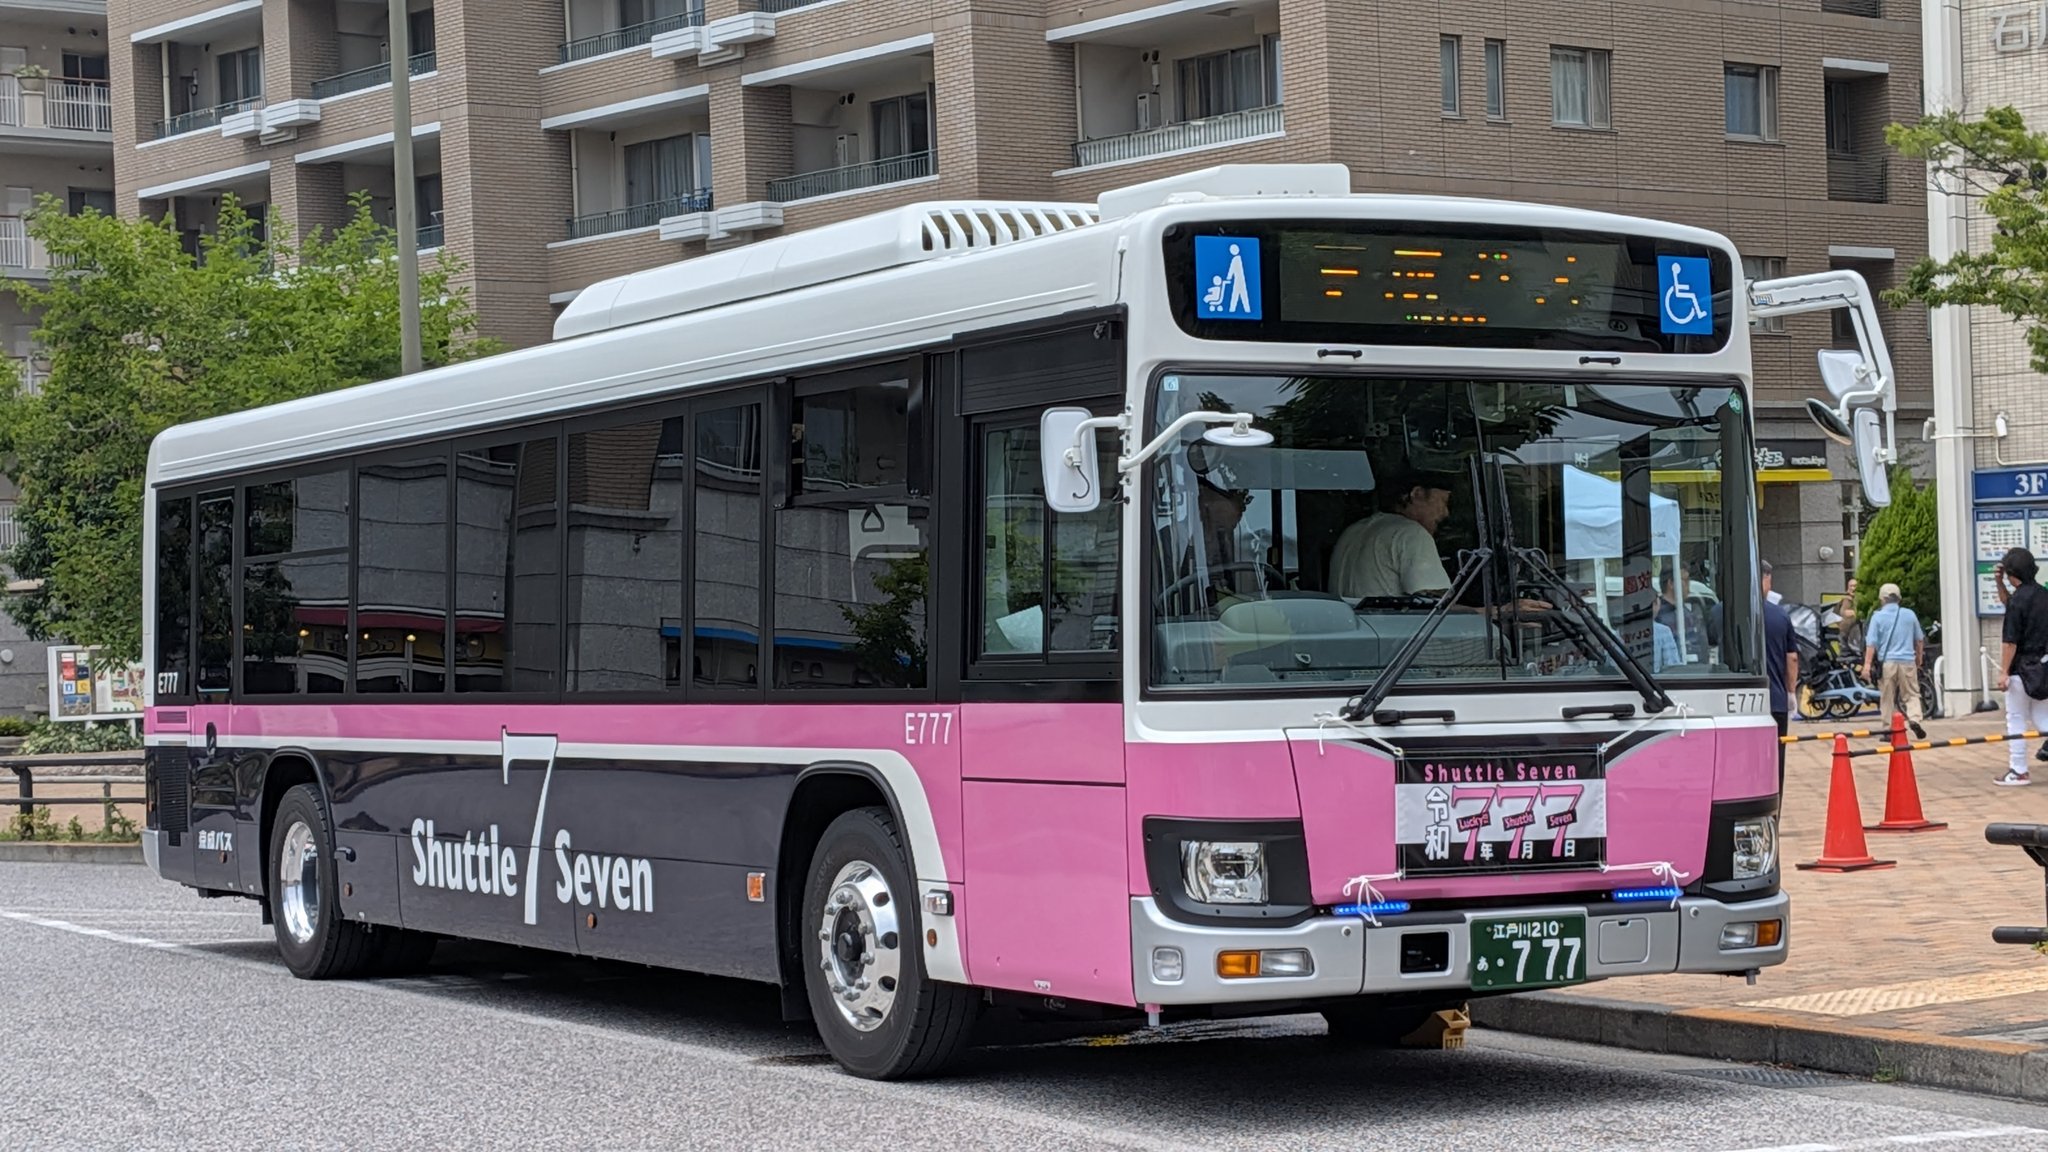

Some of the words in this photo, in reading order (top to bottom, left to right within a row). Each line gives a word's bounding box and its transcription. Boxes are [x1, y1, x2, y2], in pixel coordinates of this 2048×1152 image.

[2014, 472, 2048, 495] 3F
[158, 671, 179, 694] E777
[1726, 693, 1765, 713] E777
[905, 712, 952, 744] E777
[1424, 762, 1505, 783] Shuttle
[1517, 762, 1577, 781] Seven
[411, 817, 518, 897] Shuttle
[502, 726, 558, 925] 7
[554, 828, 654, 913] Seven
[1424, 785, 1450, 861] 令和
[1549, 812, 1574, 826] Seven
[198, 829, 233, 851] 京成バス
